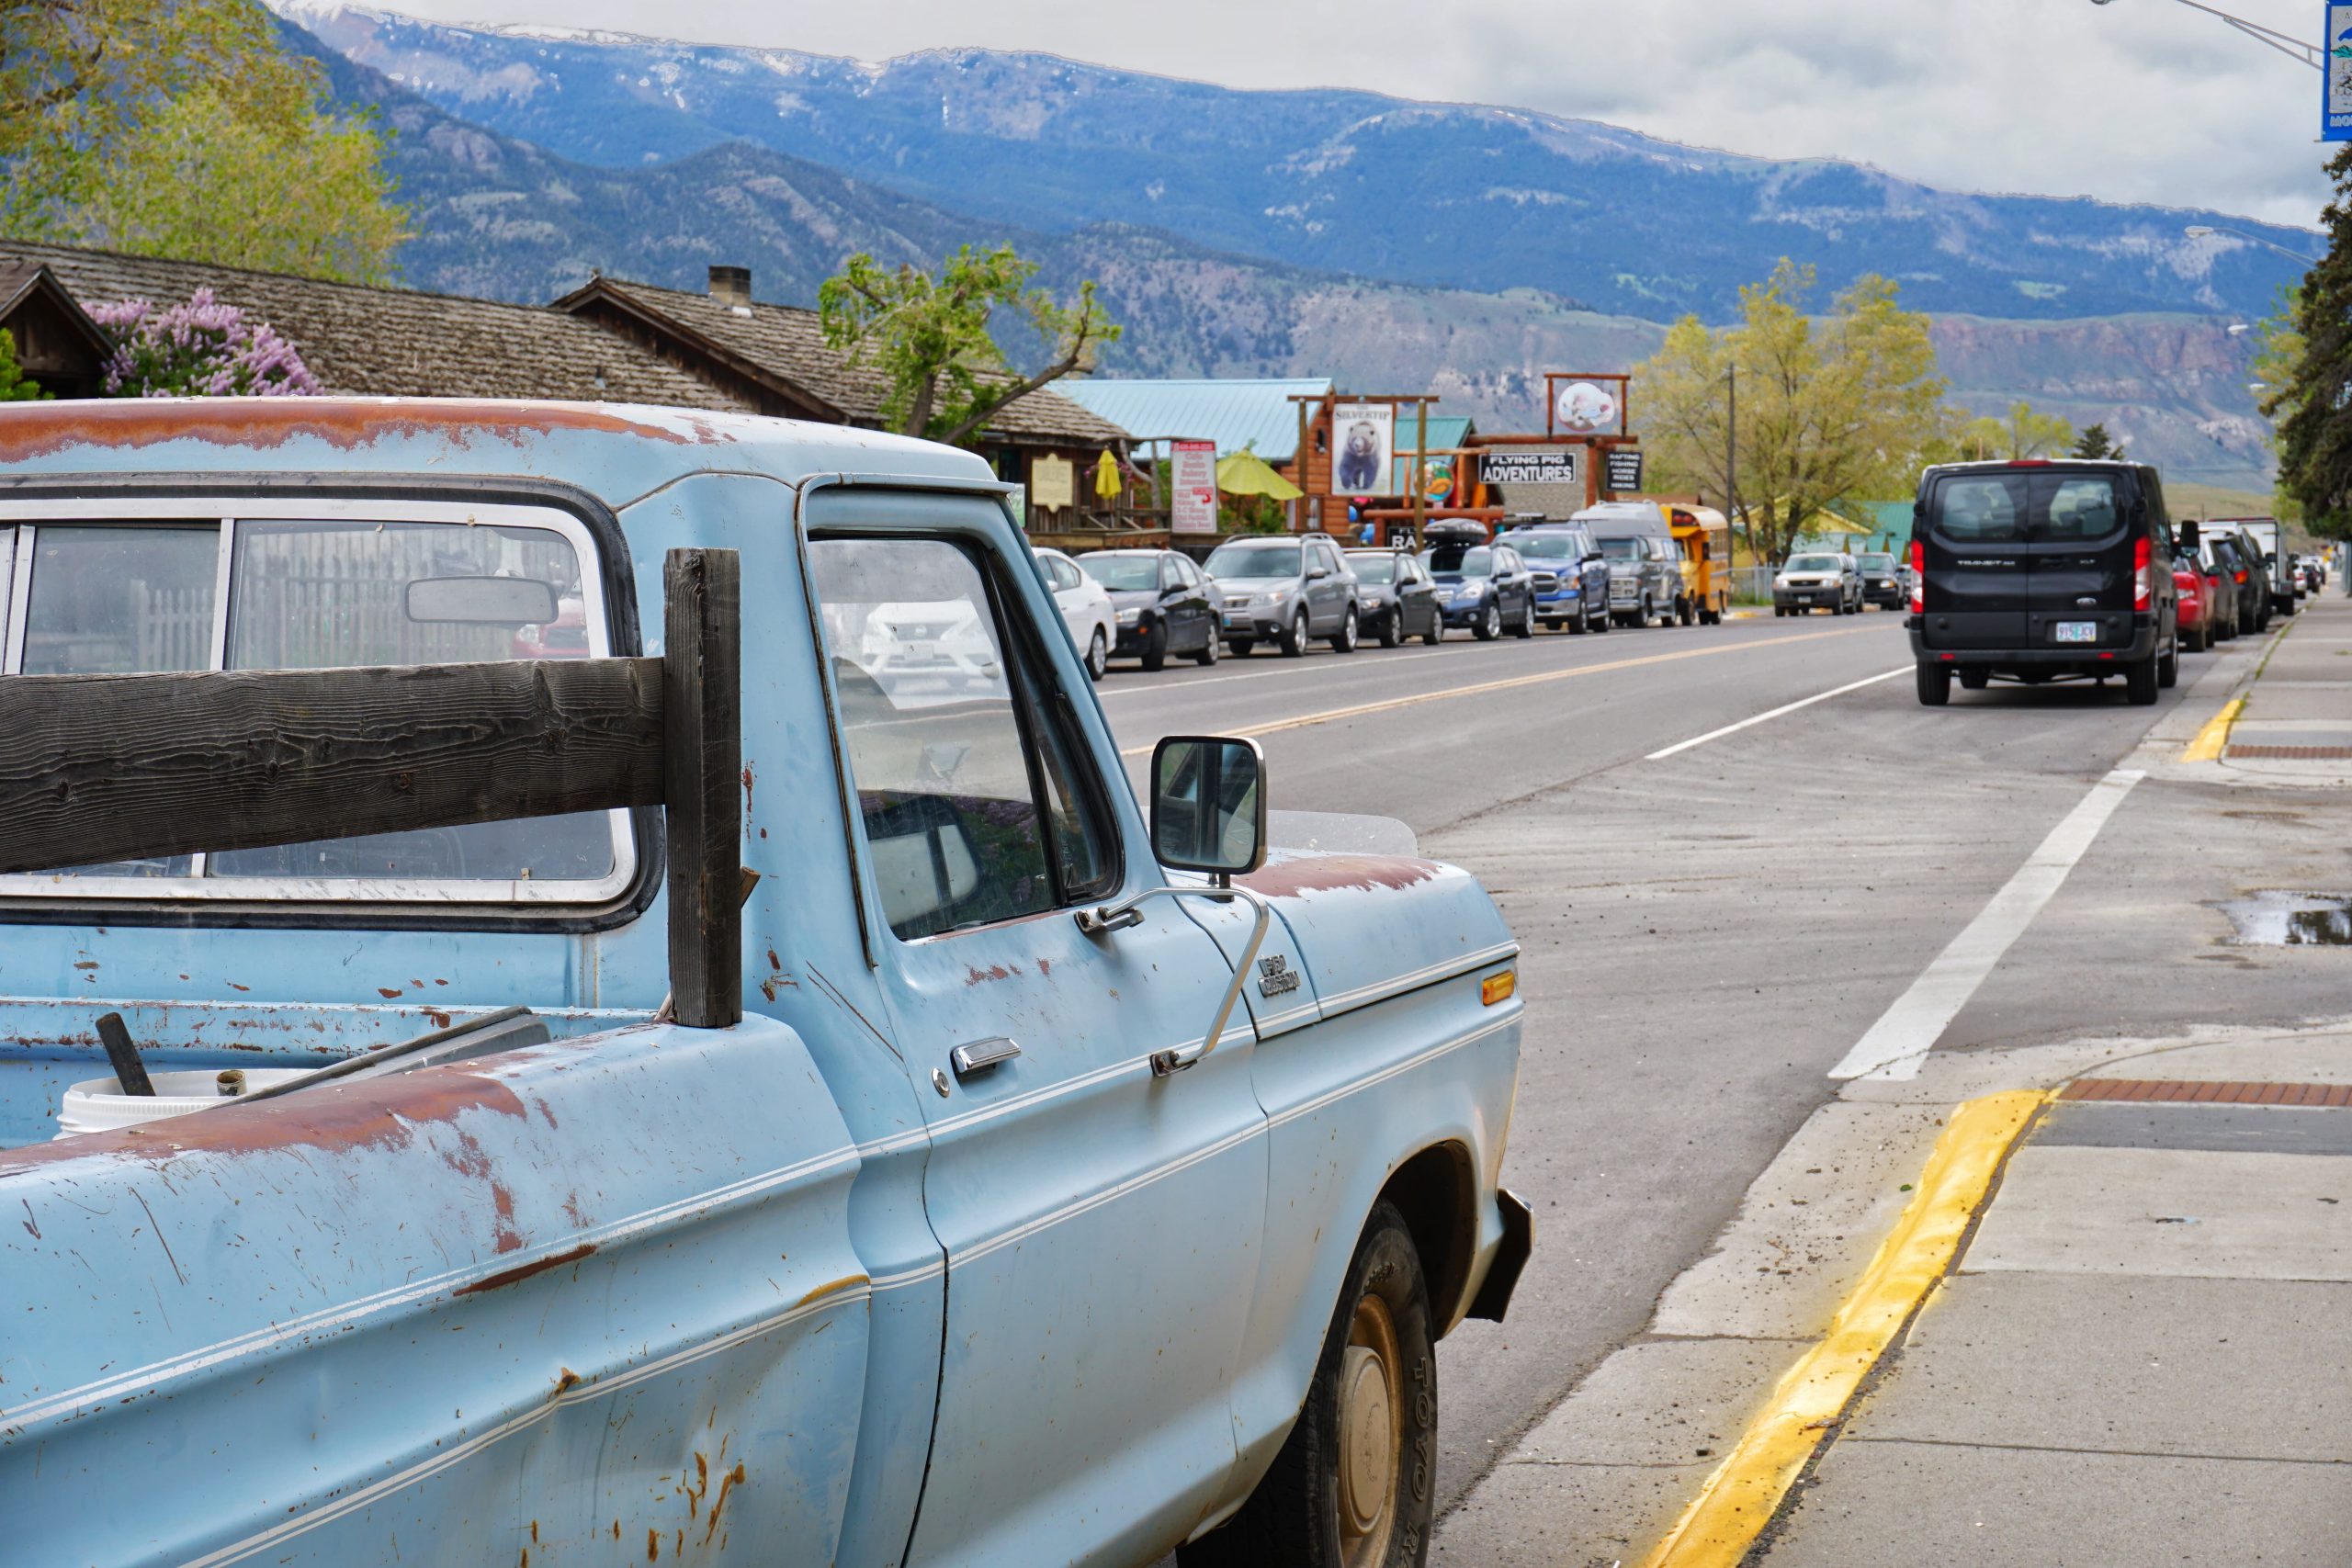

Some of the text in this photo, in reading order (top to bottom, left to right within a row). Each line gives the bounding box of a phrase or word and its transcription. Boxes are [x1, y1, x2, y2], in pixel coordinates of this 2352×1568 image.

[2329, 115, 2352, 128] MO
[1336, 411, 1389, 420] SILVERTIP
[1489, 456, 1566, 465] FLYING PIG
[1483, 466, 1573, 481] ADVENTURES
[1392, 535, 1418, 549] RA
[1258, 970, 1301, 998] CUSTOM
[1412, 1355, 1431, 1503] TOYO
